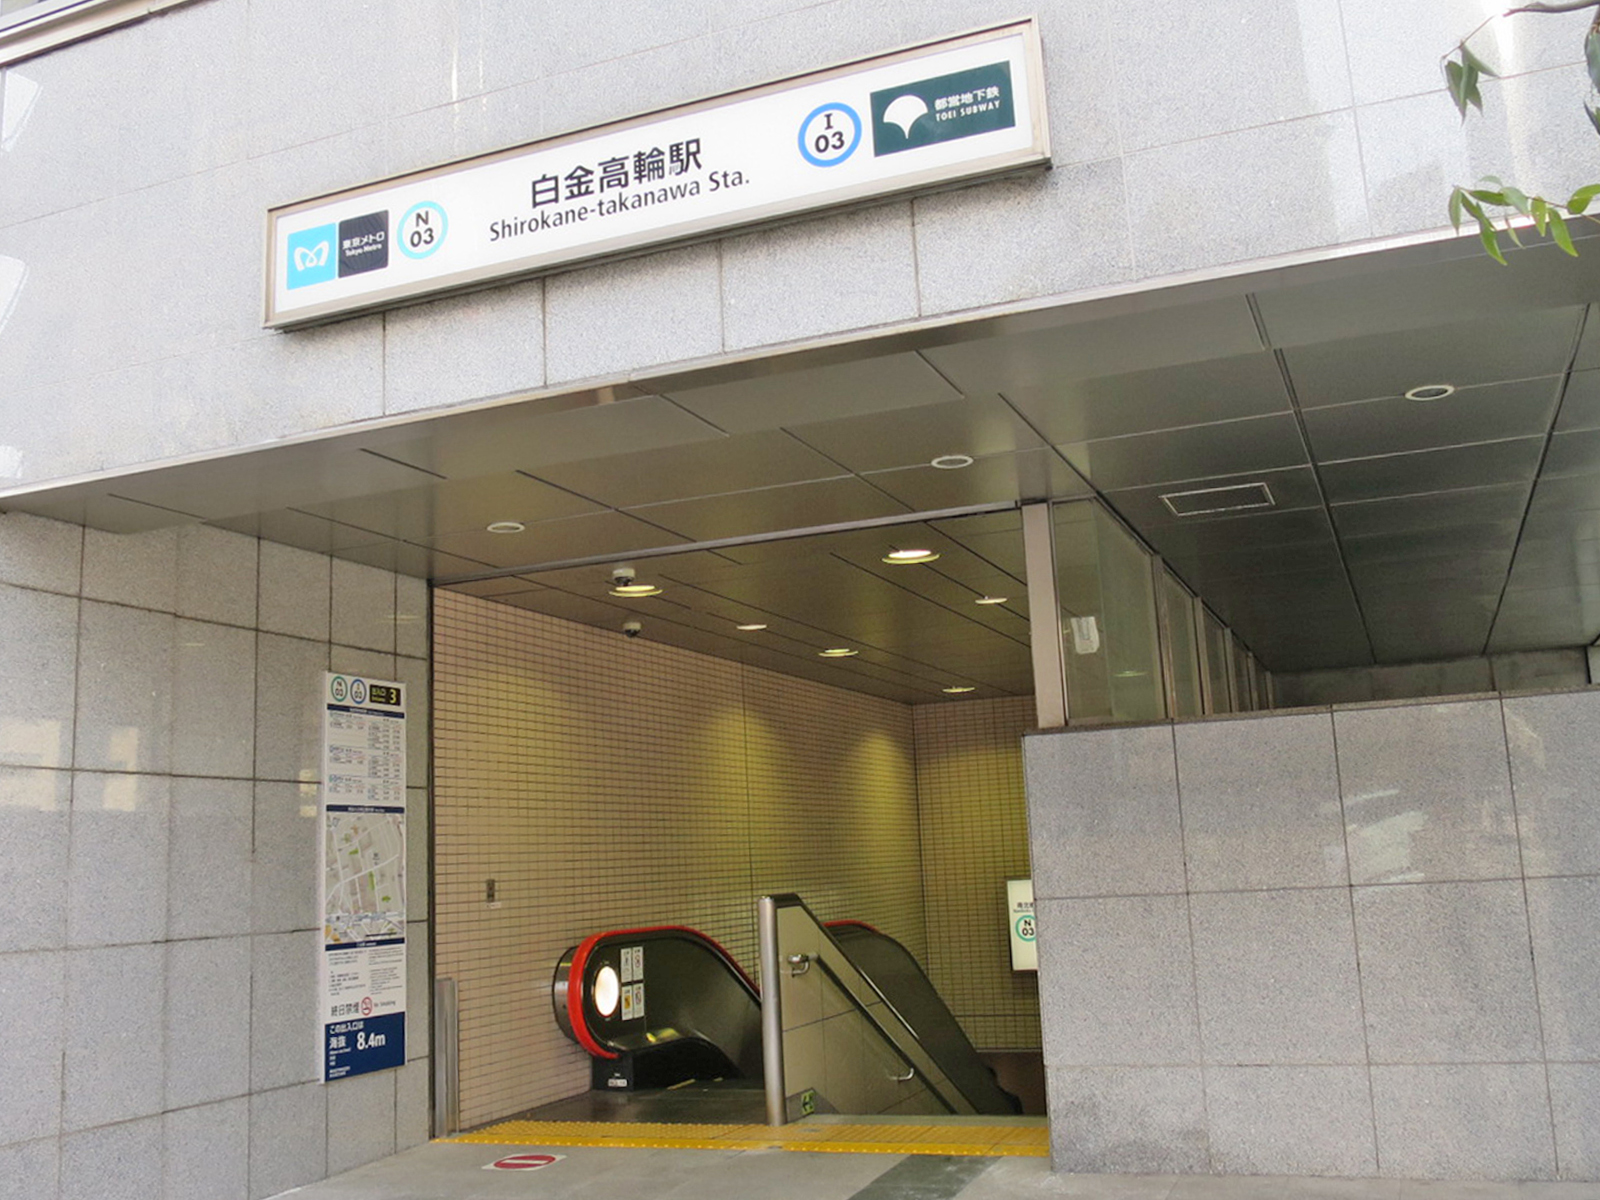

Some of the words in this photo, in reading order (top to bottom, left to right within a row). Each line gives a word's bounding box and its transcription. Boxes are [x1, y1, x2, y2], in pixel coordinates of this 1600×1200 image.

[934, 86, 1000, 111] 都営地下鉄
[935, 108, 957, 122] TOEI
[960, 100, 1001, 118] SUBWAY
[823, 113, 834, 130] I
[814, 131, 845, 153] 03
[530, 137, 703, 210] 白金高輪駅
[489, 179, 701, 242] Shirokane-takanawa
[708, 169, 750, 193] Sta.
[415, 210, 430, 228] N
[342, 231, 386, 250] 東京メトロ
[409, 227, 435, 249] 03
[345, 246, 363, 258] Tokyo
[363, 243, 382, 253] Metro
[389, 688, 397, 704] 3
[1022, 927, 1035, 936] 03
[1023, 919, 1032, 927] N
[356, 1031, 386, 1050] 8.4m
